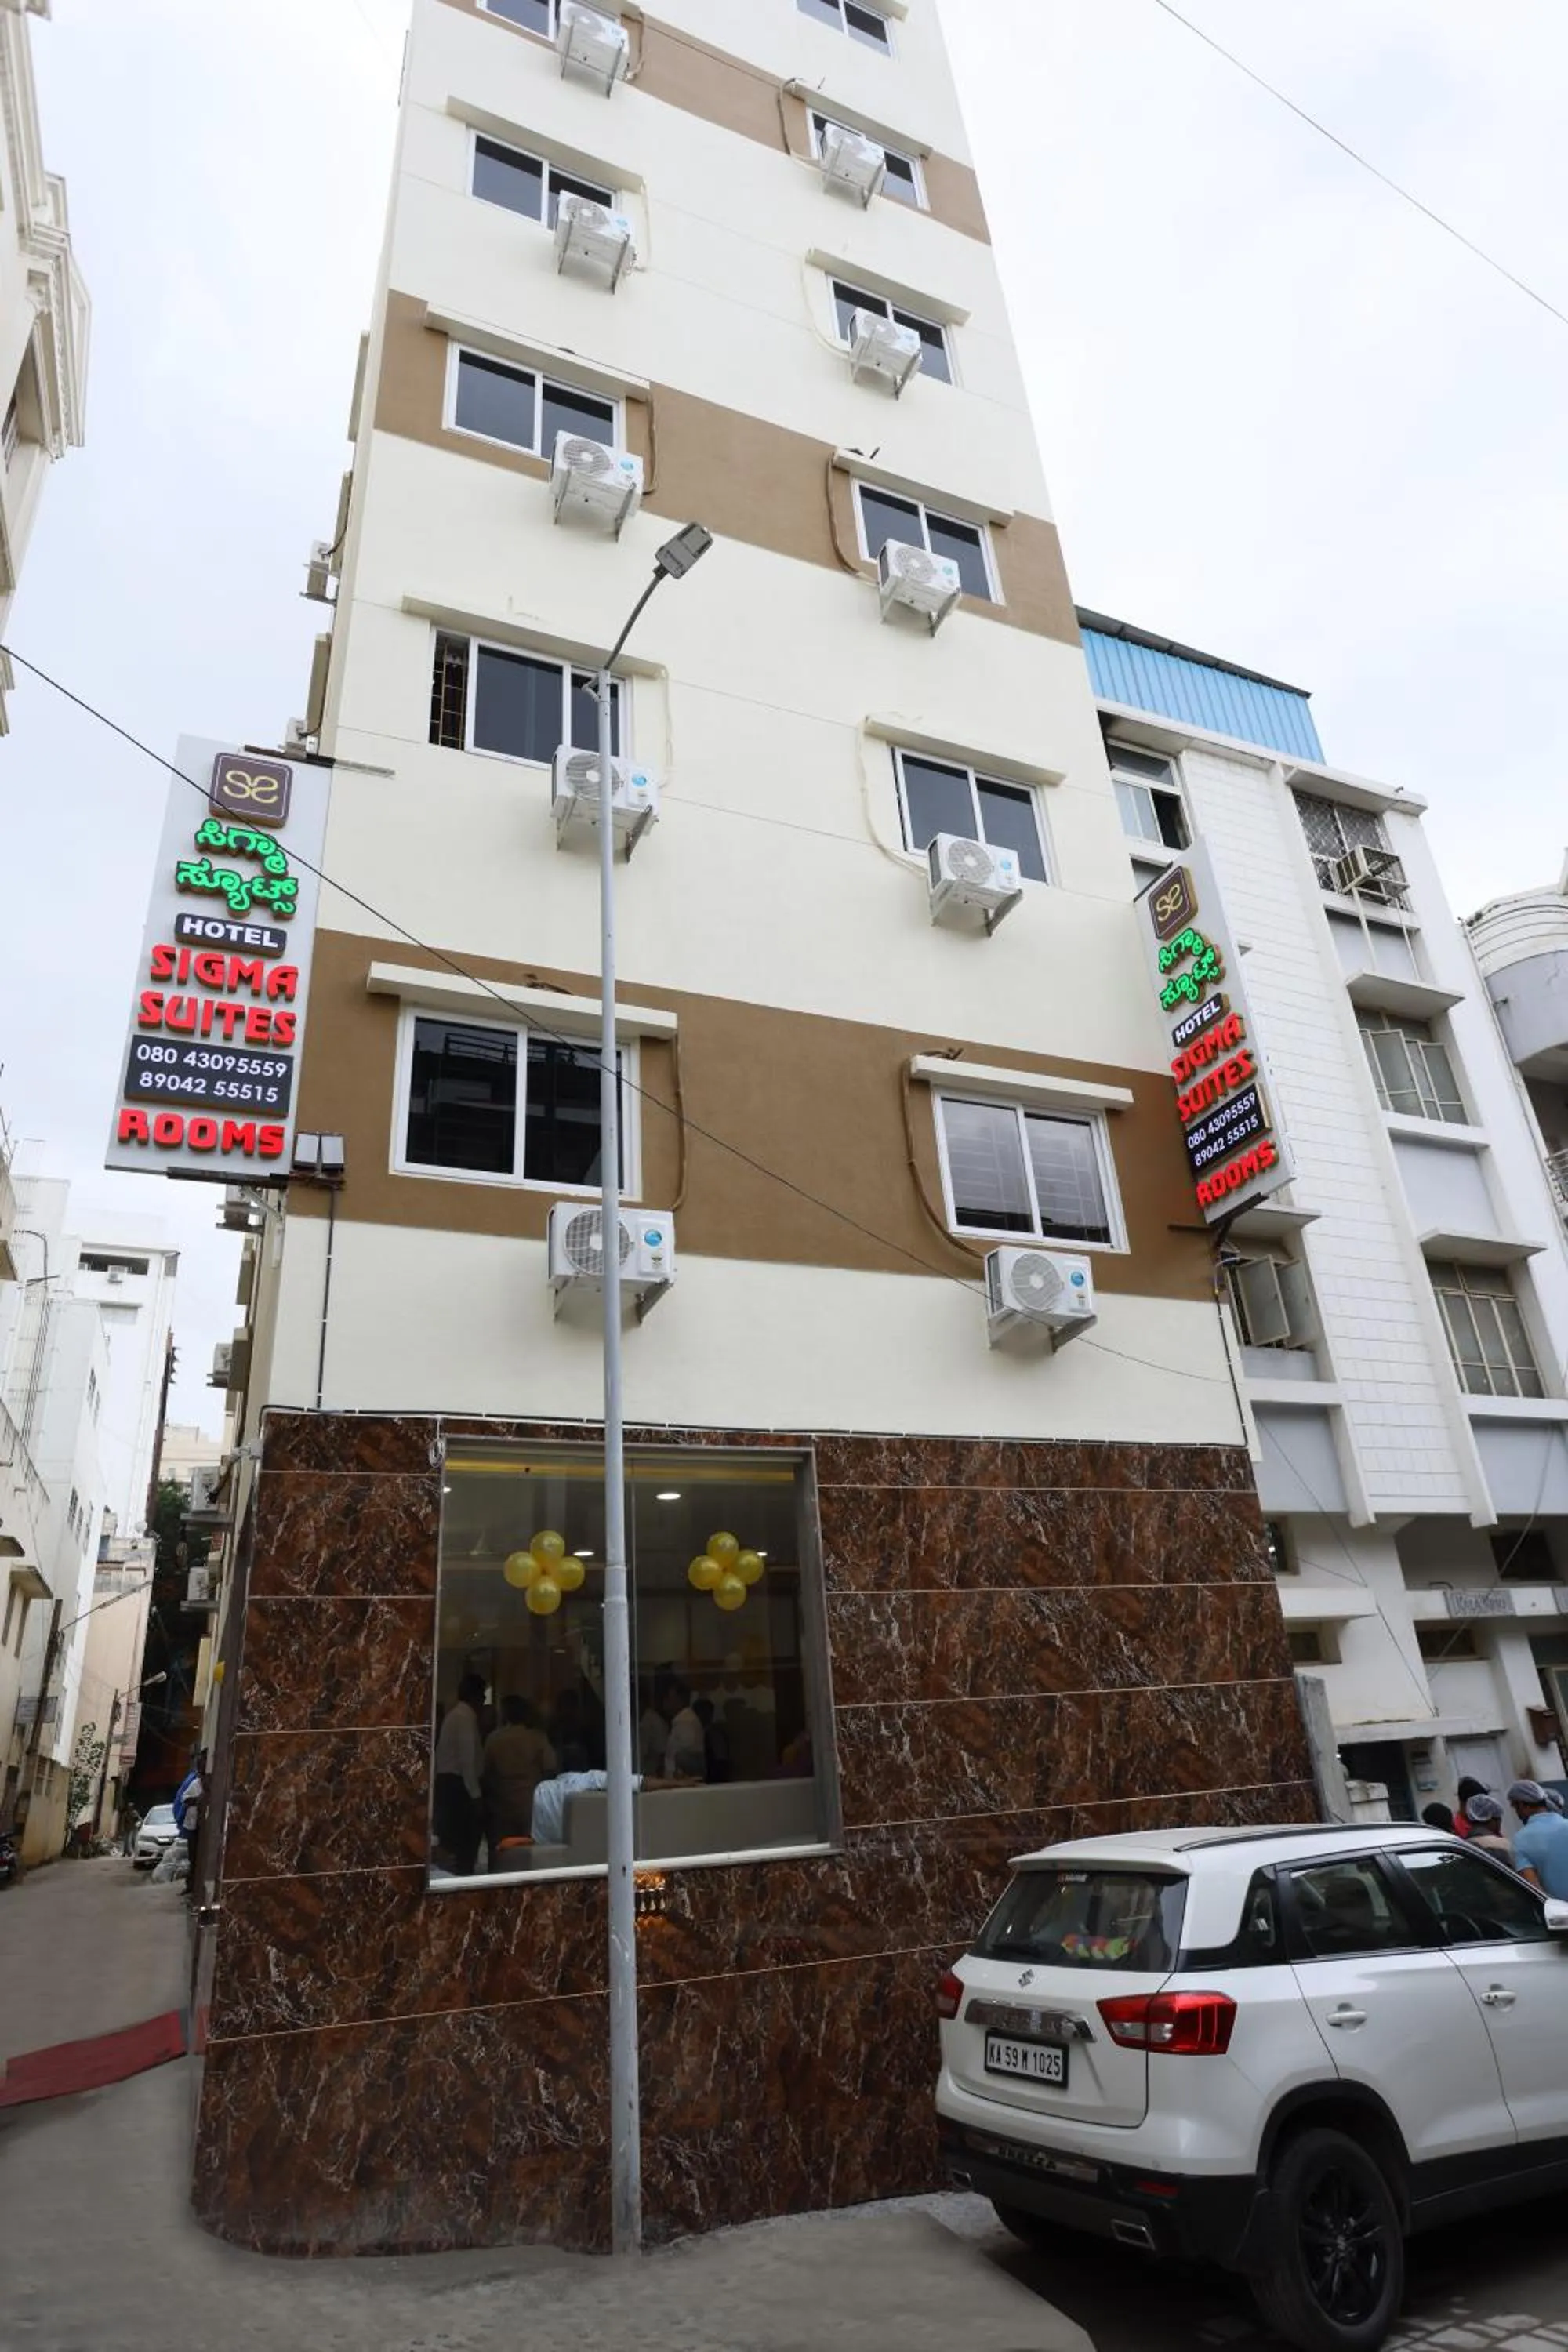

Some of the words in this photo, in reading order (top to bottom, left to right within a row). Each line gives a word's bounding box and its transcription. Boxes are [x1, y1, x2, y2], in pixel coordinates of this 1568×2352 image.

[183, 916, 278, 948] HOTEL
[150, 943, 299, 1000] SIGMA
[137, 991, 296, 1047] SUITES
[1175, 1000, 1221, 1044] HOTEL
[136, 1043, 177, 1065] 080
[183, 1051, 288, 1079] 43095559
[1171, 1012, 1243, 1084] SIGMA
[139, 1071, 207, 1094] 89042
[212, 1080, 278, 1102] 55515
[1176, 1047, 1256, 1123] SUITES
[117, 1108, 285, 1160] ROOMS
[1188, 1129, 1207, 1149] 080
[1207, 1092, 1256, 1137] 43095559
[1195, 1143, 1225, 1167] 89042
[1227, 1116, 1258, 1147] 55515
[1195, 1138, 1279, 1209] ROOMS
[989, 2043, 1001, 2064] KA
[1006, 2046, 1018, 2067] 59
[1022, 2049, 1029, 2070] M
[1033, 2053, 1061, 2076] 1025
